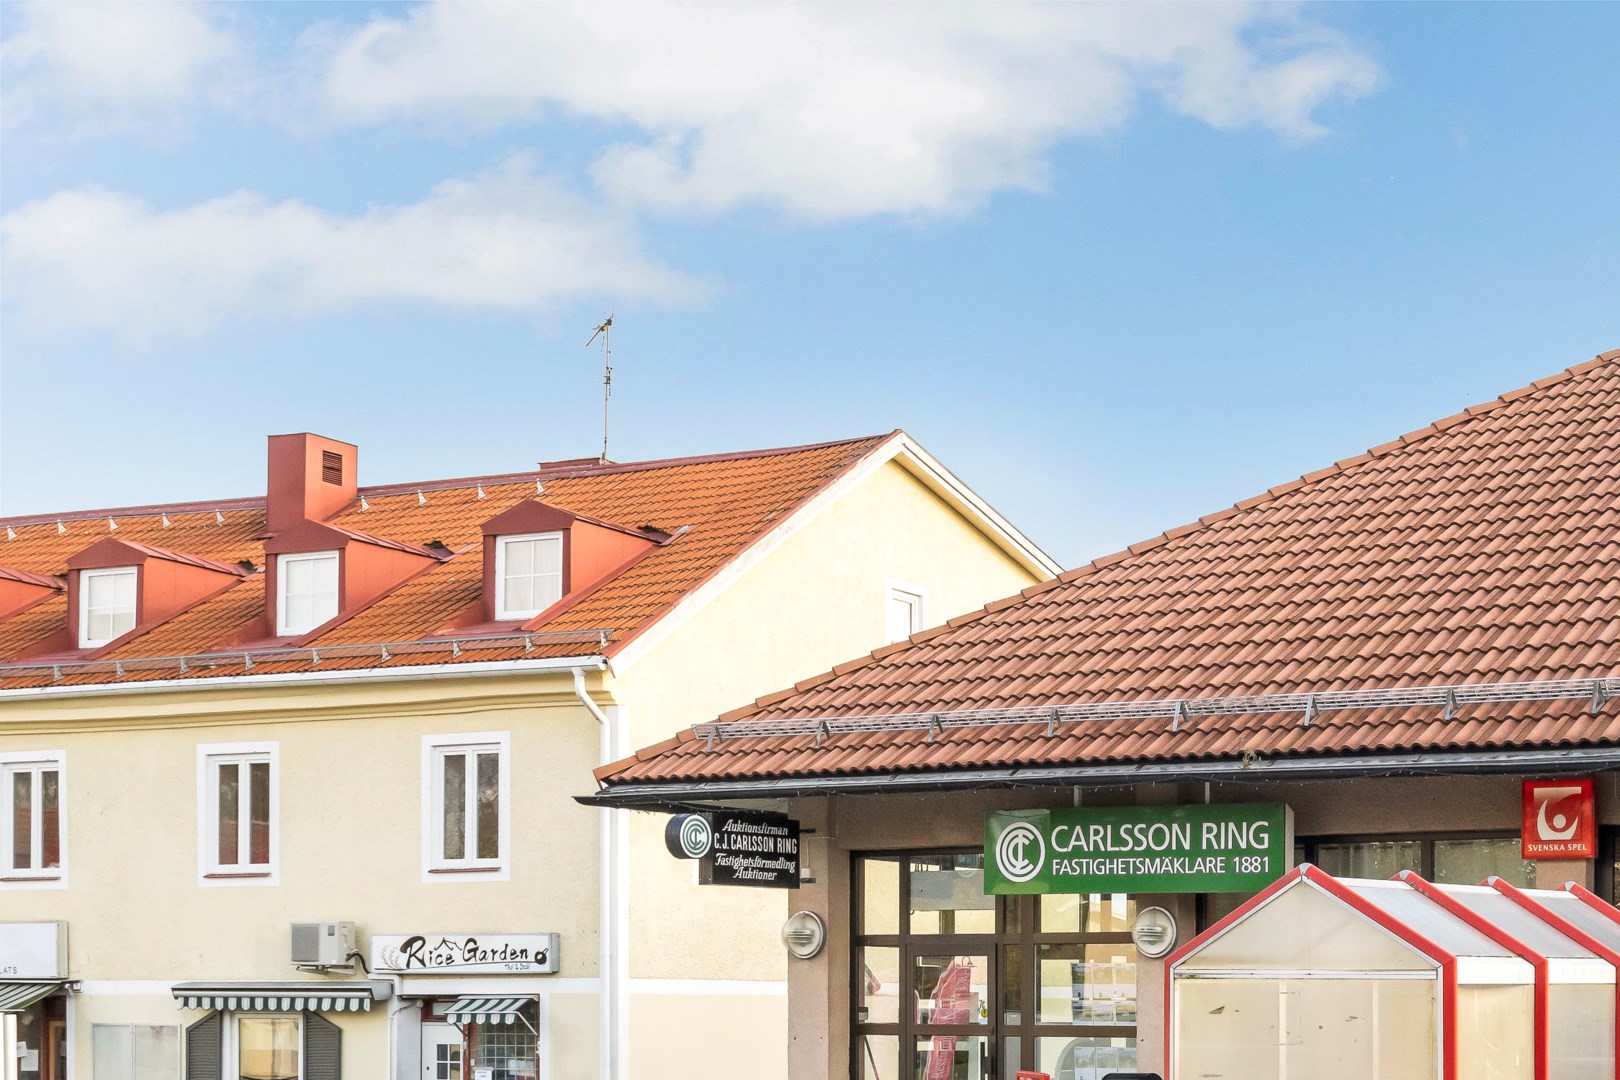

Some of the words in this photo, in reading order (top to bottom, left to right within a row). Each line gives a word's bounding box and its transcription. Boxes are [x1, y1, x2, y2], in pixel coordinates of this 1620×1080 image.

[722, 819, 788, 835] Auktionsfirman
[1051, 823, 1191, 852] CARLSSON
[1202, 821, 1270, 850] RING
[731, 834, 774, 853] CARLSSON
[777, 838, 797, 854] RING
[1528, 844, 1565, 852] SVENSKA
[1567, 843, 1588, 851] SPEL
[715, 853, 796, 873] Fastighetsförmedling
[1052, 856, 1226, 875] FASTIGHETSMÄKLARE
[1233, 856, 1270, 873] 1881
[733, 867, 777, 880] Auktioner
[400, 936, 455, 969] Rice
[462, 937, 529, 963] Garden
